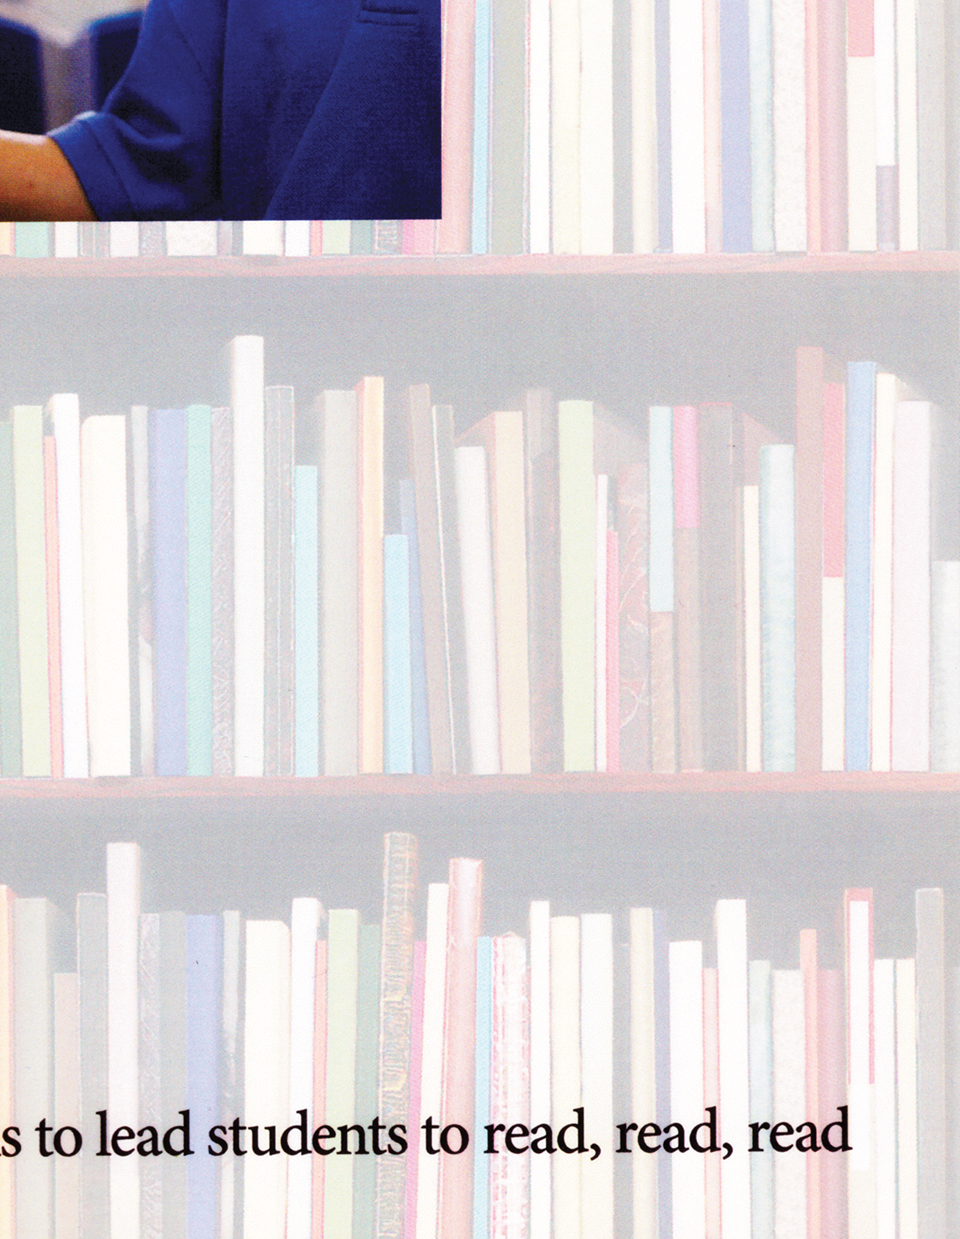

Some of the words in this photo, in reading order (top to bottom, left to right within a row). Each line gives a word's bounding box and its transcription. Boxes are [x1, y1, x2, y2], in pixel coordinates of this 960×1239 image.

[34, 1118, 83, 1157] to
[95, 1109, 195, 1157] lead
[207, 1108, 408, 1157] students
[421, 1116, 470, 1155] to
[483, 1106, 601, 1161] read,
[615, 1105, 733, 1160] read,
[748, 1105, 853, 1153] read
